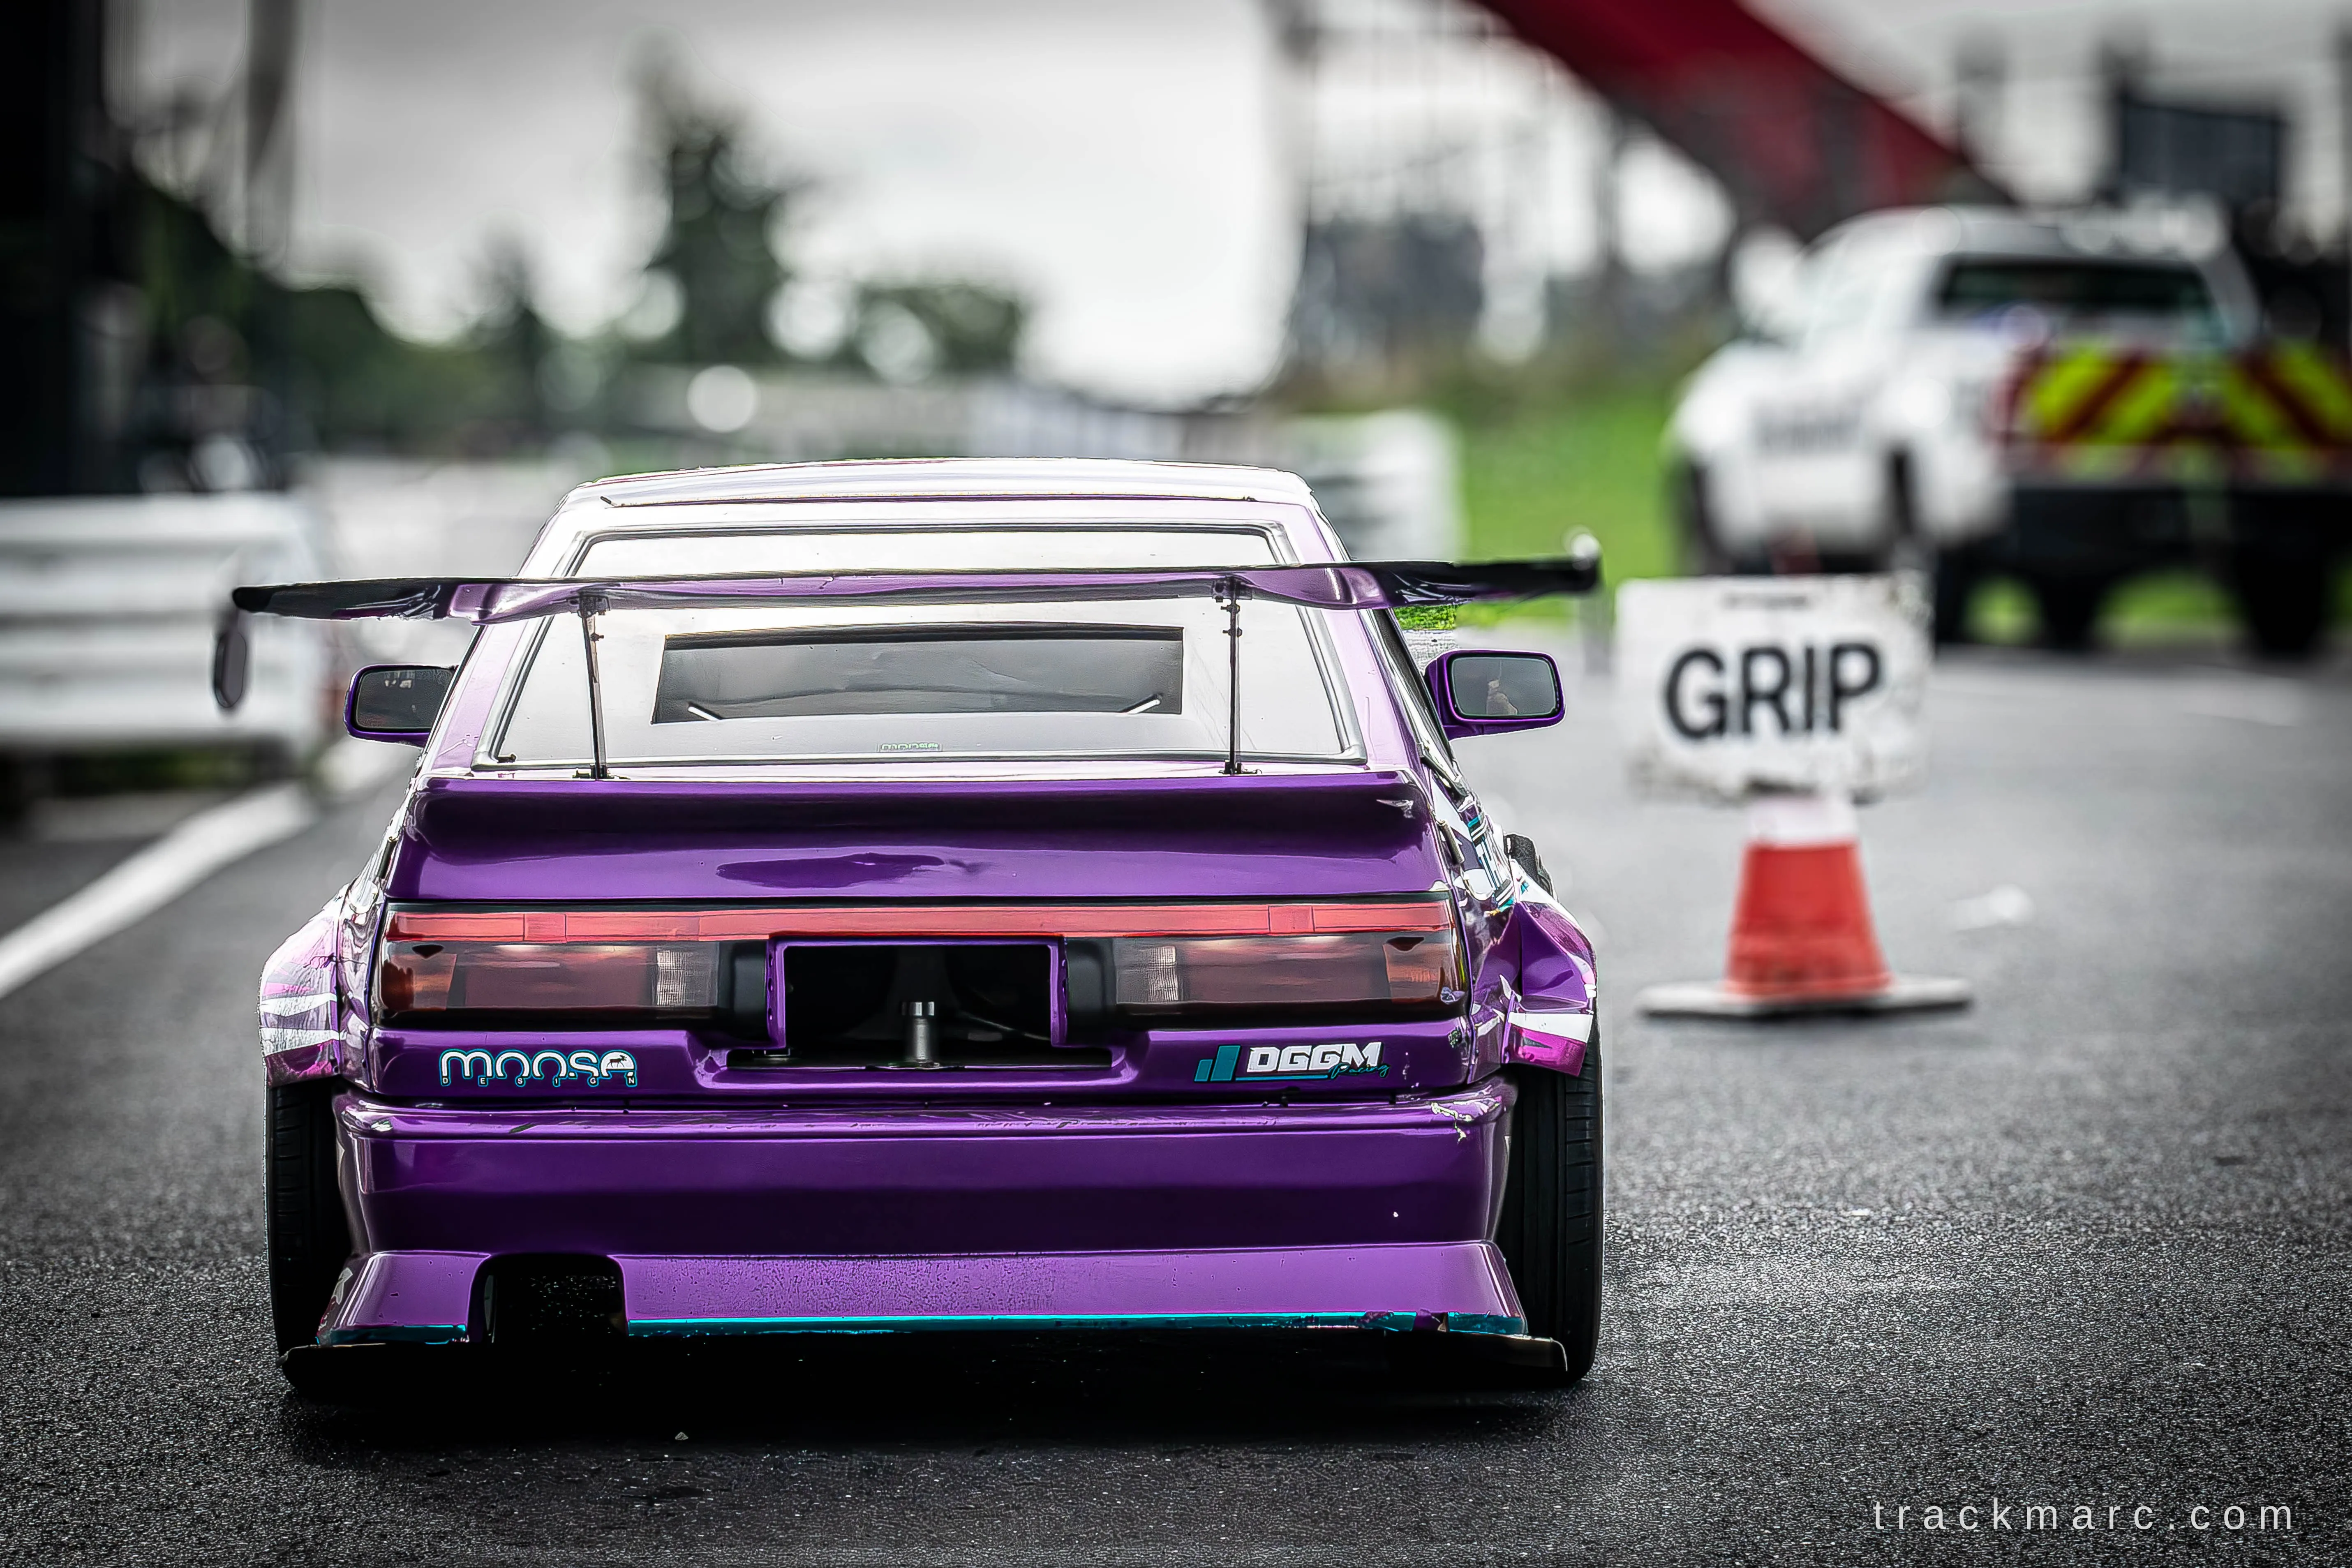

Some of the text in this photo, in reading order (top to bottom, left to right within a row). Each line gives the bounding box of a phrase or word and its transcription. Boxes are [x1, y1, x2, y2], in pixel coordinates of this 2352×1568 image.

[1666, 642, 1881, 738] GRIP
[1247, 1041, 1382, 1072] DGGM
[1328, 1062, 1391, 1079] Racing
